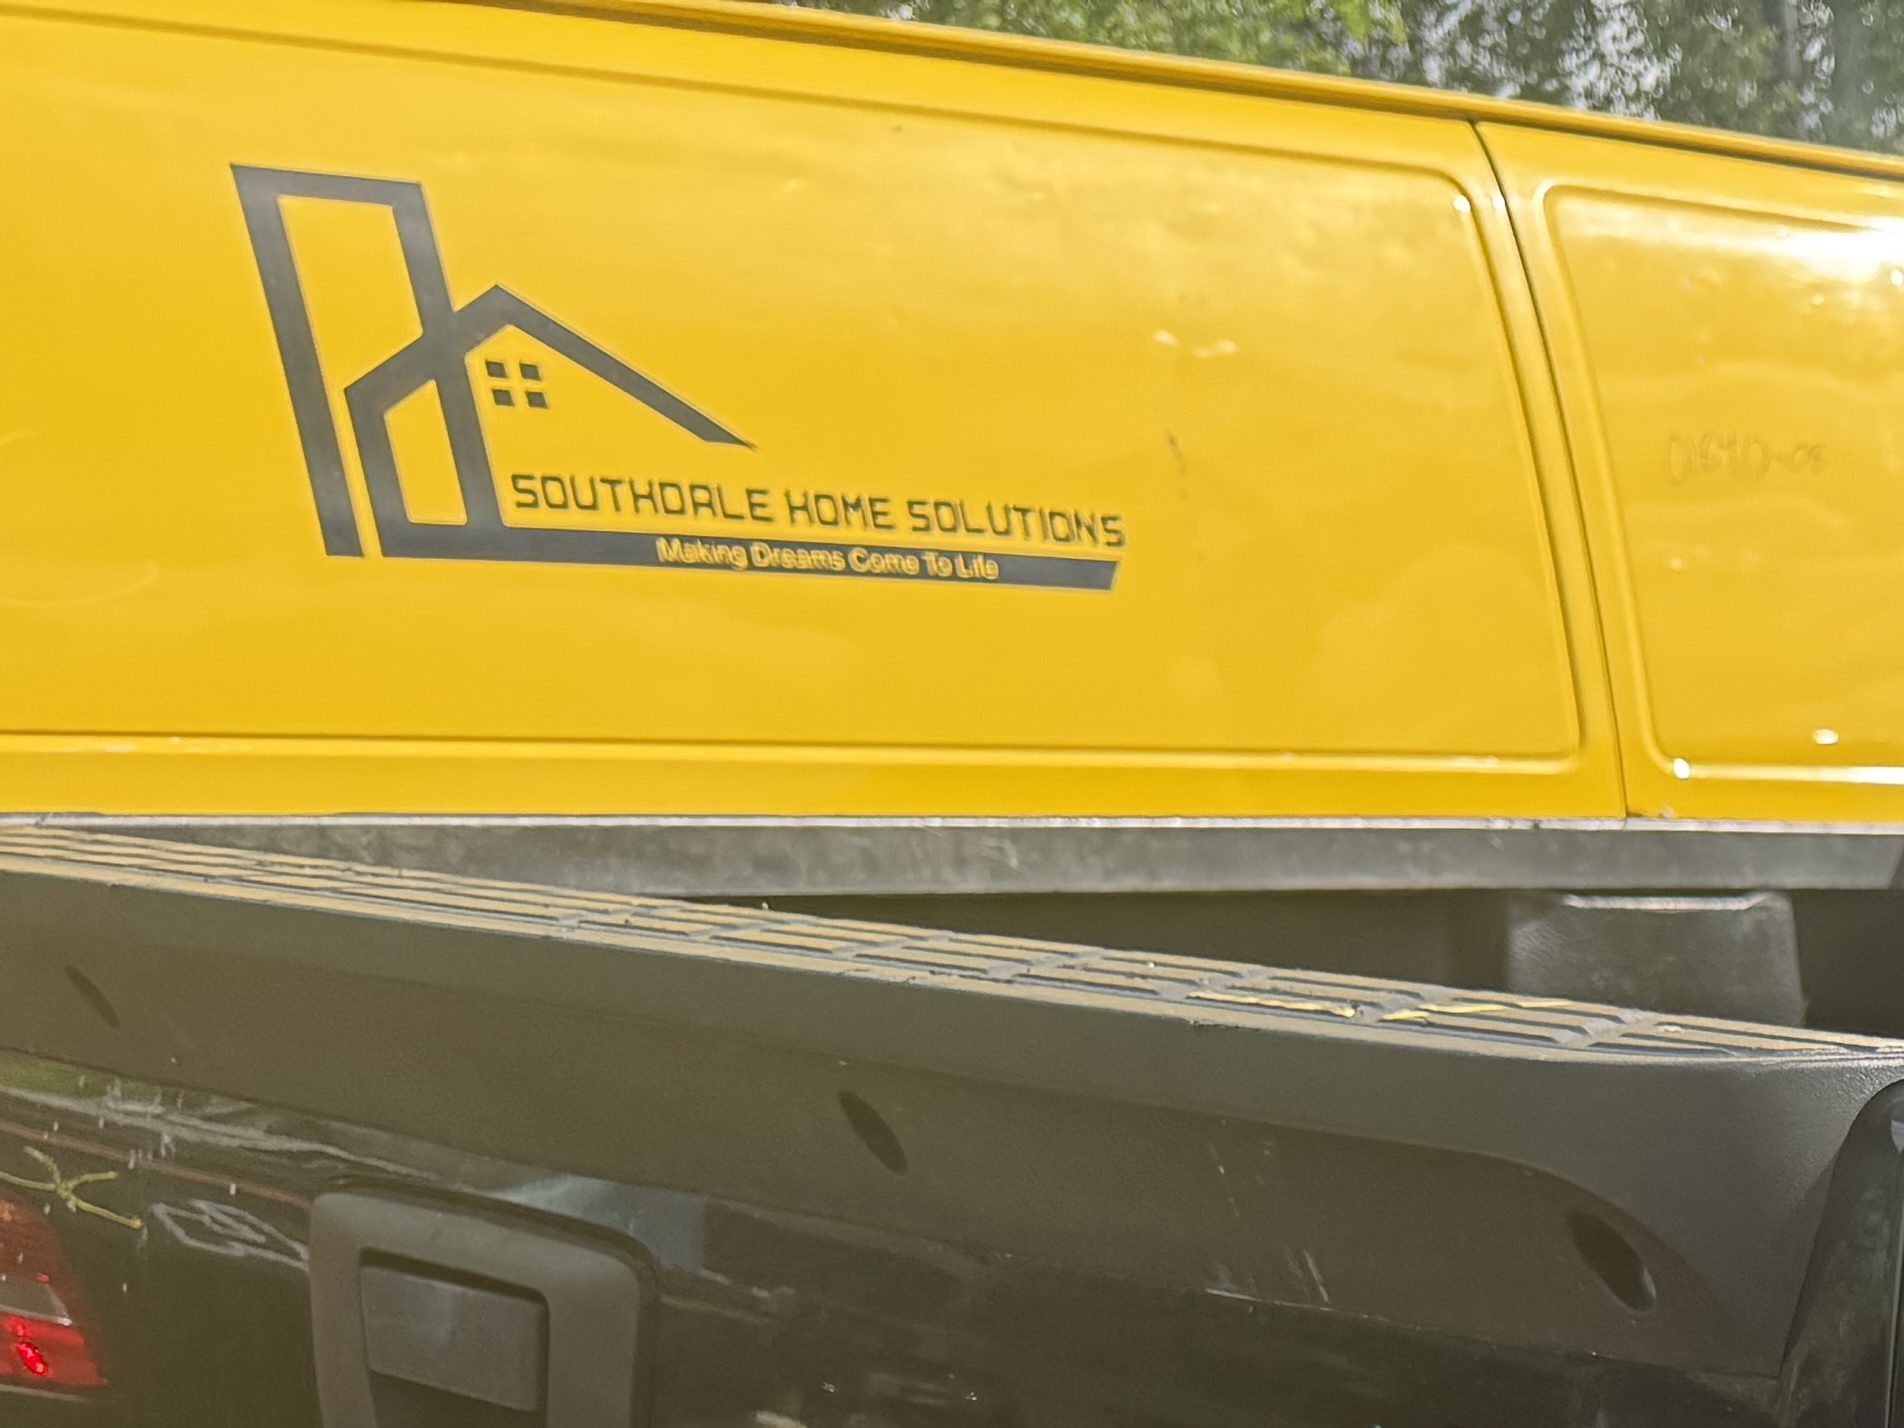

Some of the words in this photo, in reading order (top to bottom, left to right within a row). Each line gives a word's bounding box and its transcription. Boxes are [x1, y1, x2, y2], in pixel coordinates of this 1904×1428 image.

[510, 473, 773, 523] SOUTHDALE
[787, 488, 897, 530] HOME
[907, 499, 1128, 549] SOLUTIONS
[655, 536, 748, 570] Making
[750, 541, 847, 573] Dreams
[849, 546, 920, 576] Come
[923, 548, 953, 577] To
[955, 552, 1000, 581] Life
